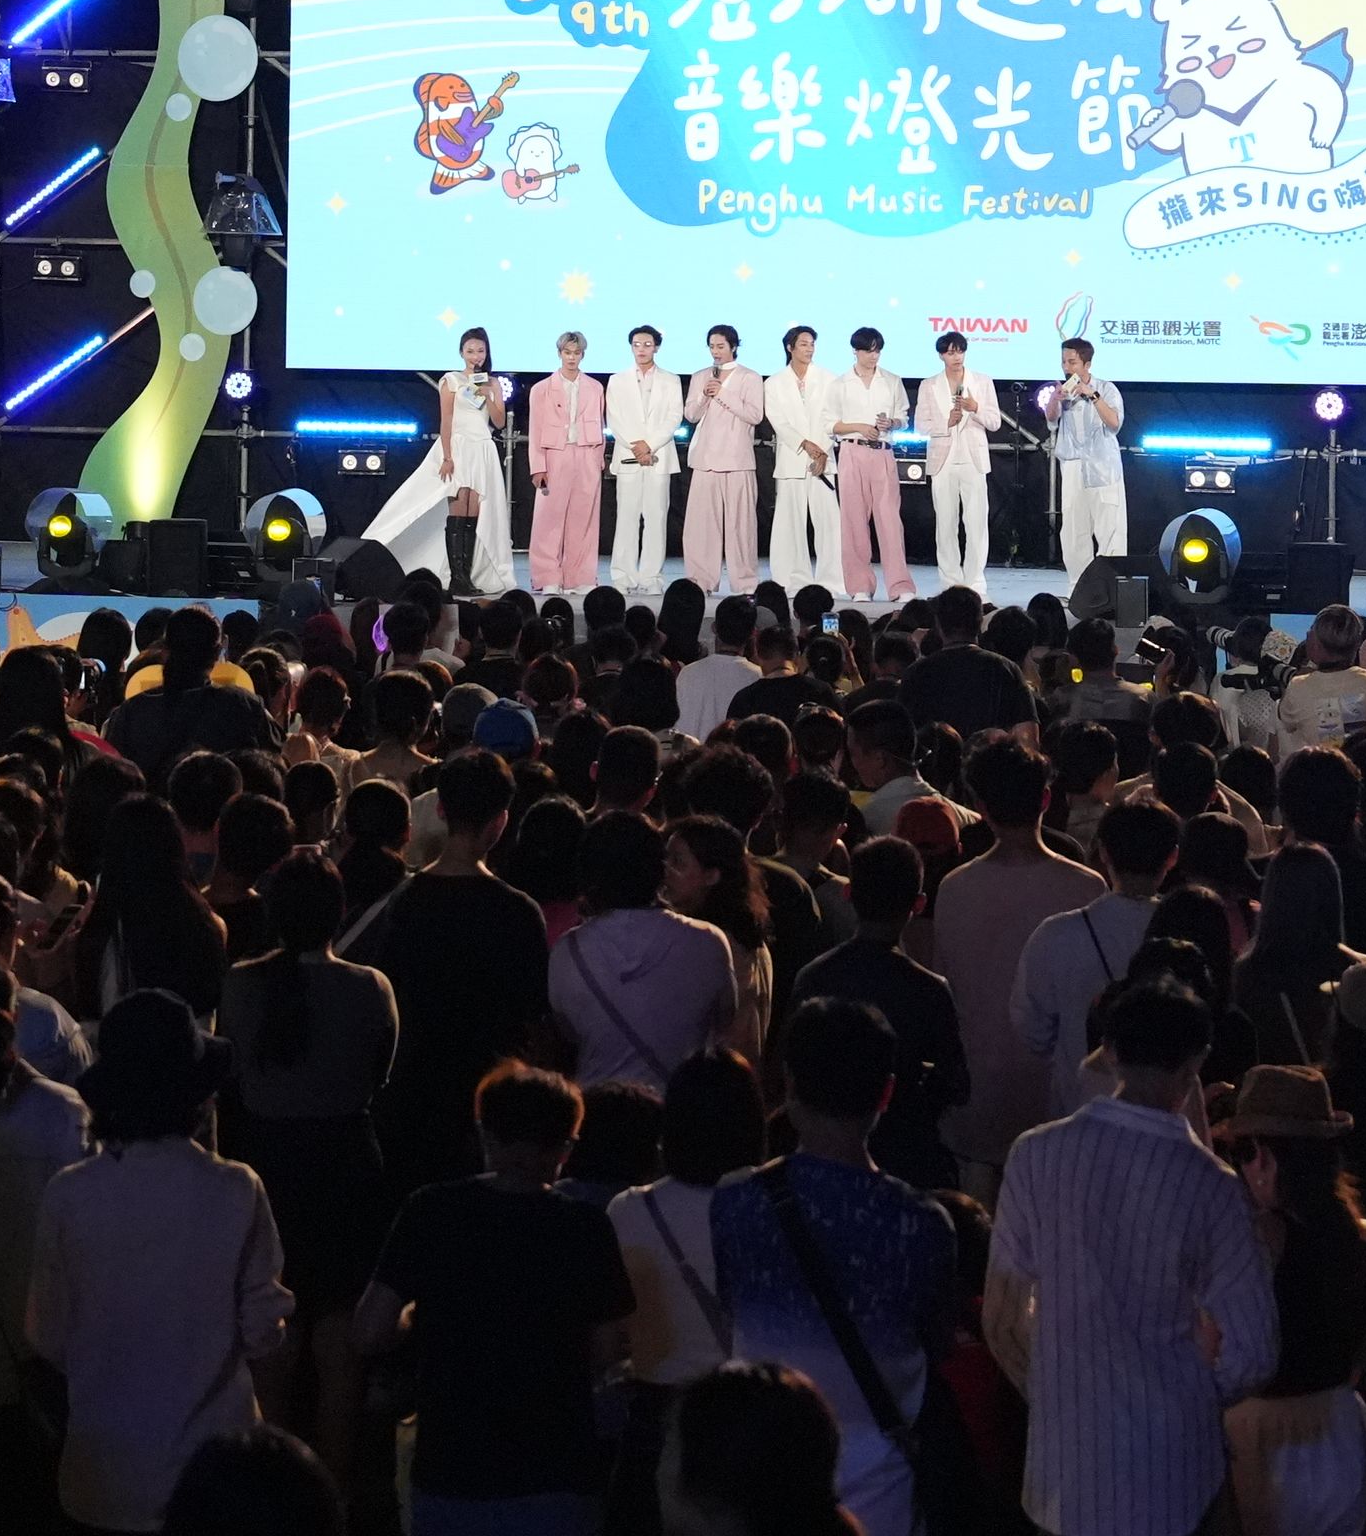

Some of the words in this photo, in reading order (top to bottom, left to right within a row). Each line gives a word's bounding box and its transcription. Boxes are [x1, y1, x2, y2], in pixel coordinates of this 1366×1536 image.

[570, 0, 650, 39] 9th
[673, 48, 1153, 171] 音樂燈光節
[699, 179, 823, 232] Penghu
[846, 183, 944, 213] Music
[963, 184, 1094, 216] Festival
[928, 317, 1028, 333] TAIWAN
[1100, 320, 1222, 337] 交通部觀光署
[1100, 337, 1132, 345] Tourism
